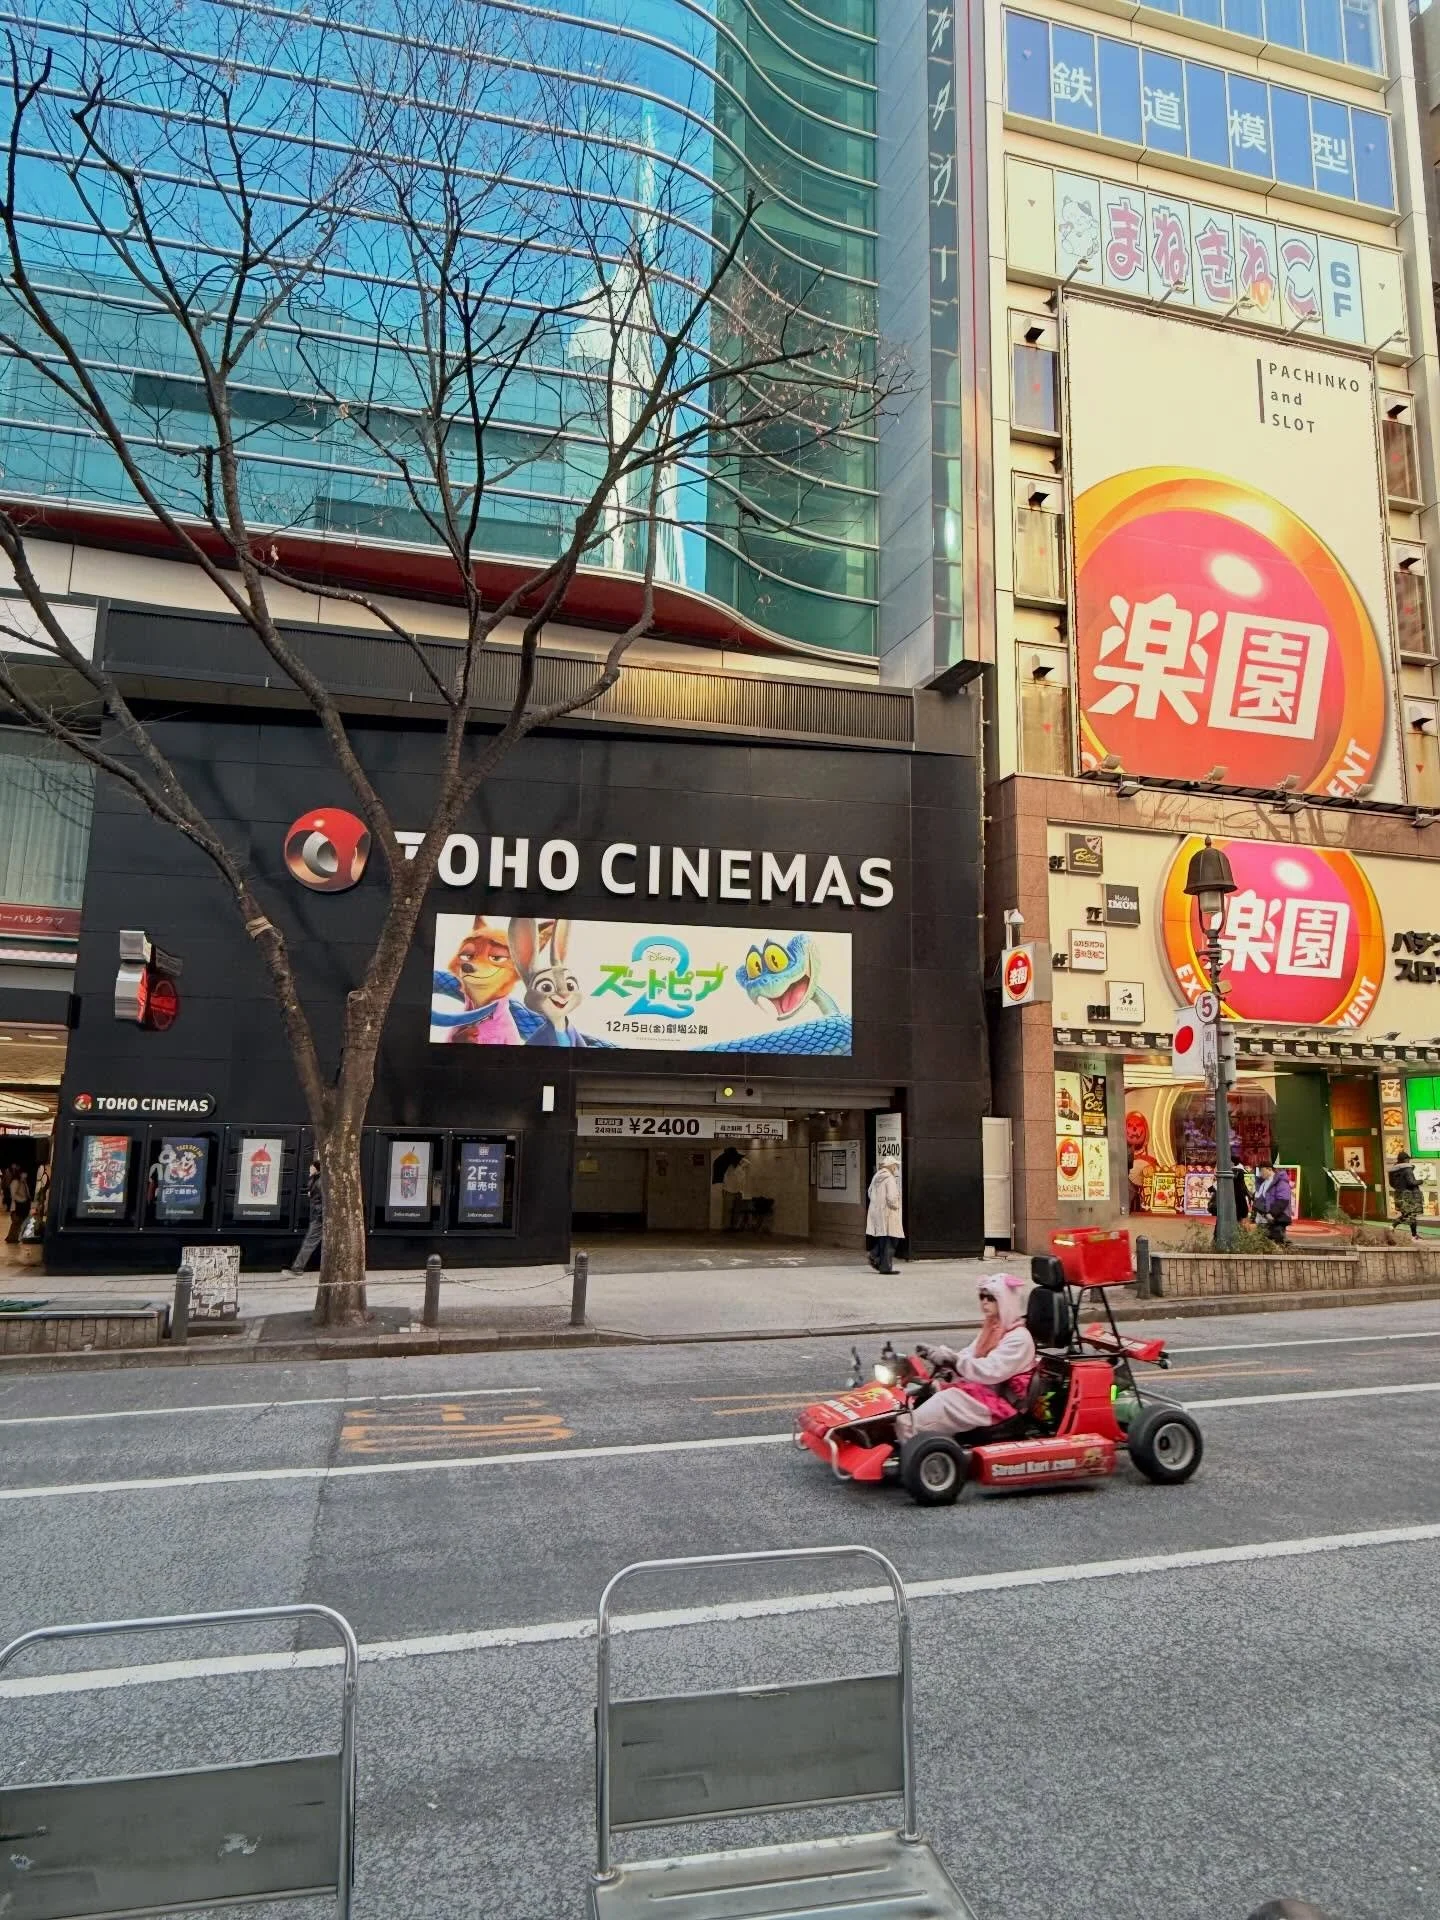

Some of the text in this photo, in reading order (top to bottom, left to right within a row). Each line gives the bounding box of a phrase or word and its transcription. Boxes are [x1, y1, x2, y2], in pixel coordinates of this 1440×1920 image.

[1052, 60, 1349, 174] 鉄道模型
[1106, 197, 1320, 322] まねきねこ
[1330, 260, 1352, 318] 6F
[1269, 362, 1359, 392] PACHINKO
[1270, 391, 1302, 405] and
[1272, 413, 1315, 432] SLOT
[1087, 592, 1330, 740] 楽園
[1072, 847, 1099, 863] Bee
[600, 843, 895, 909] CINEMAS
[1086, 906, 1103, 921] 7F
[1107, 899, 1138, 910] IMON
[1203, 888, 1350, 979] 楽園
[647, 951, 676, 964] Disney
[1394, 958, 1440, 985] スロ
[590, 961, 729, 1002] ズートピア
[1201, 995, 1213, 1018] 5
[96, 1097, 209, 1112] TOHO CINEMAS
[1083, 1092, 1104, 1111] Bee
[629, 1117, 700, 1136] ¥2400
[745, 1123, 770, 1134] 1.55
[878, 1143, 900, 1157] ¥2400
[467, 1165, 498, 1181] 2Fで
[467, 1181, 498, 1192] 販売中
